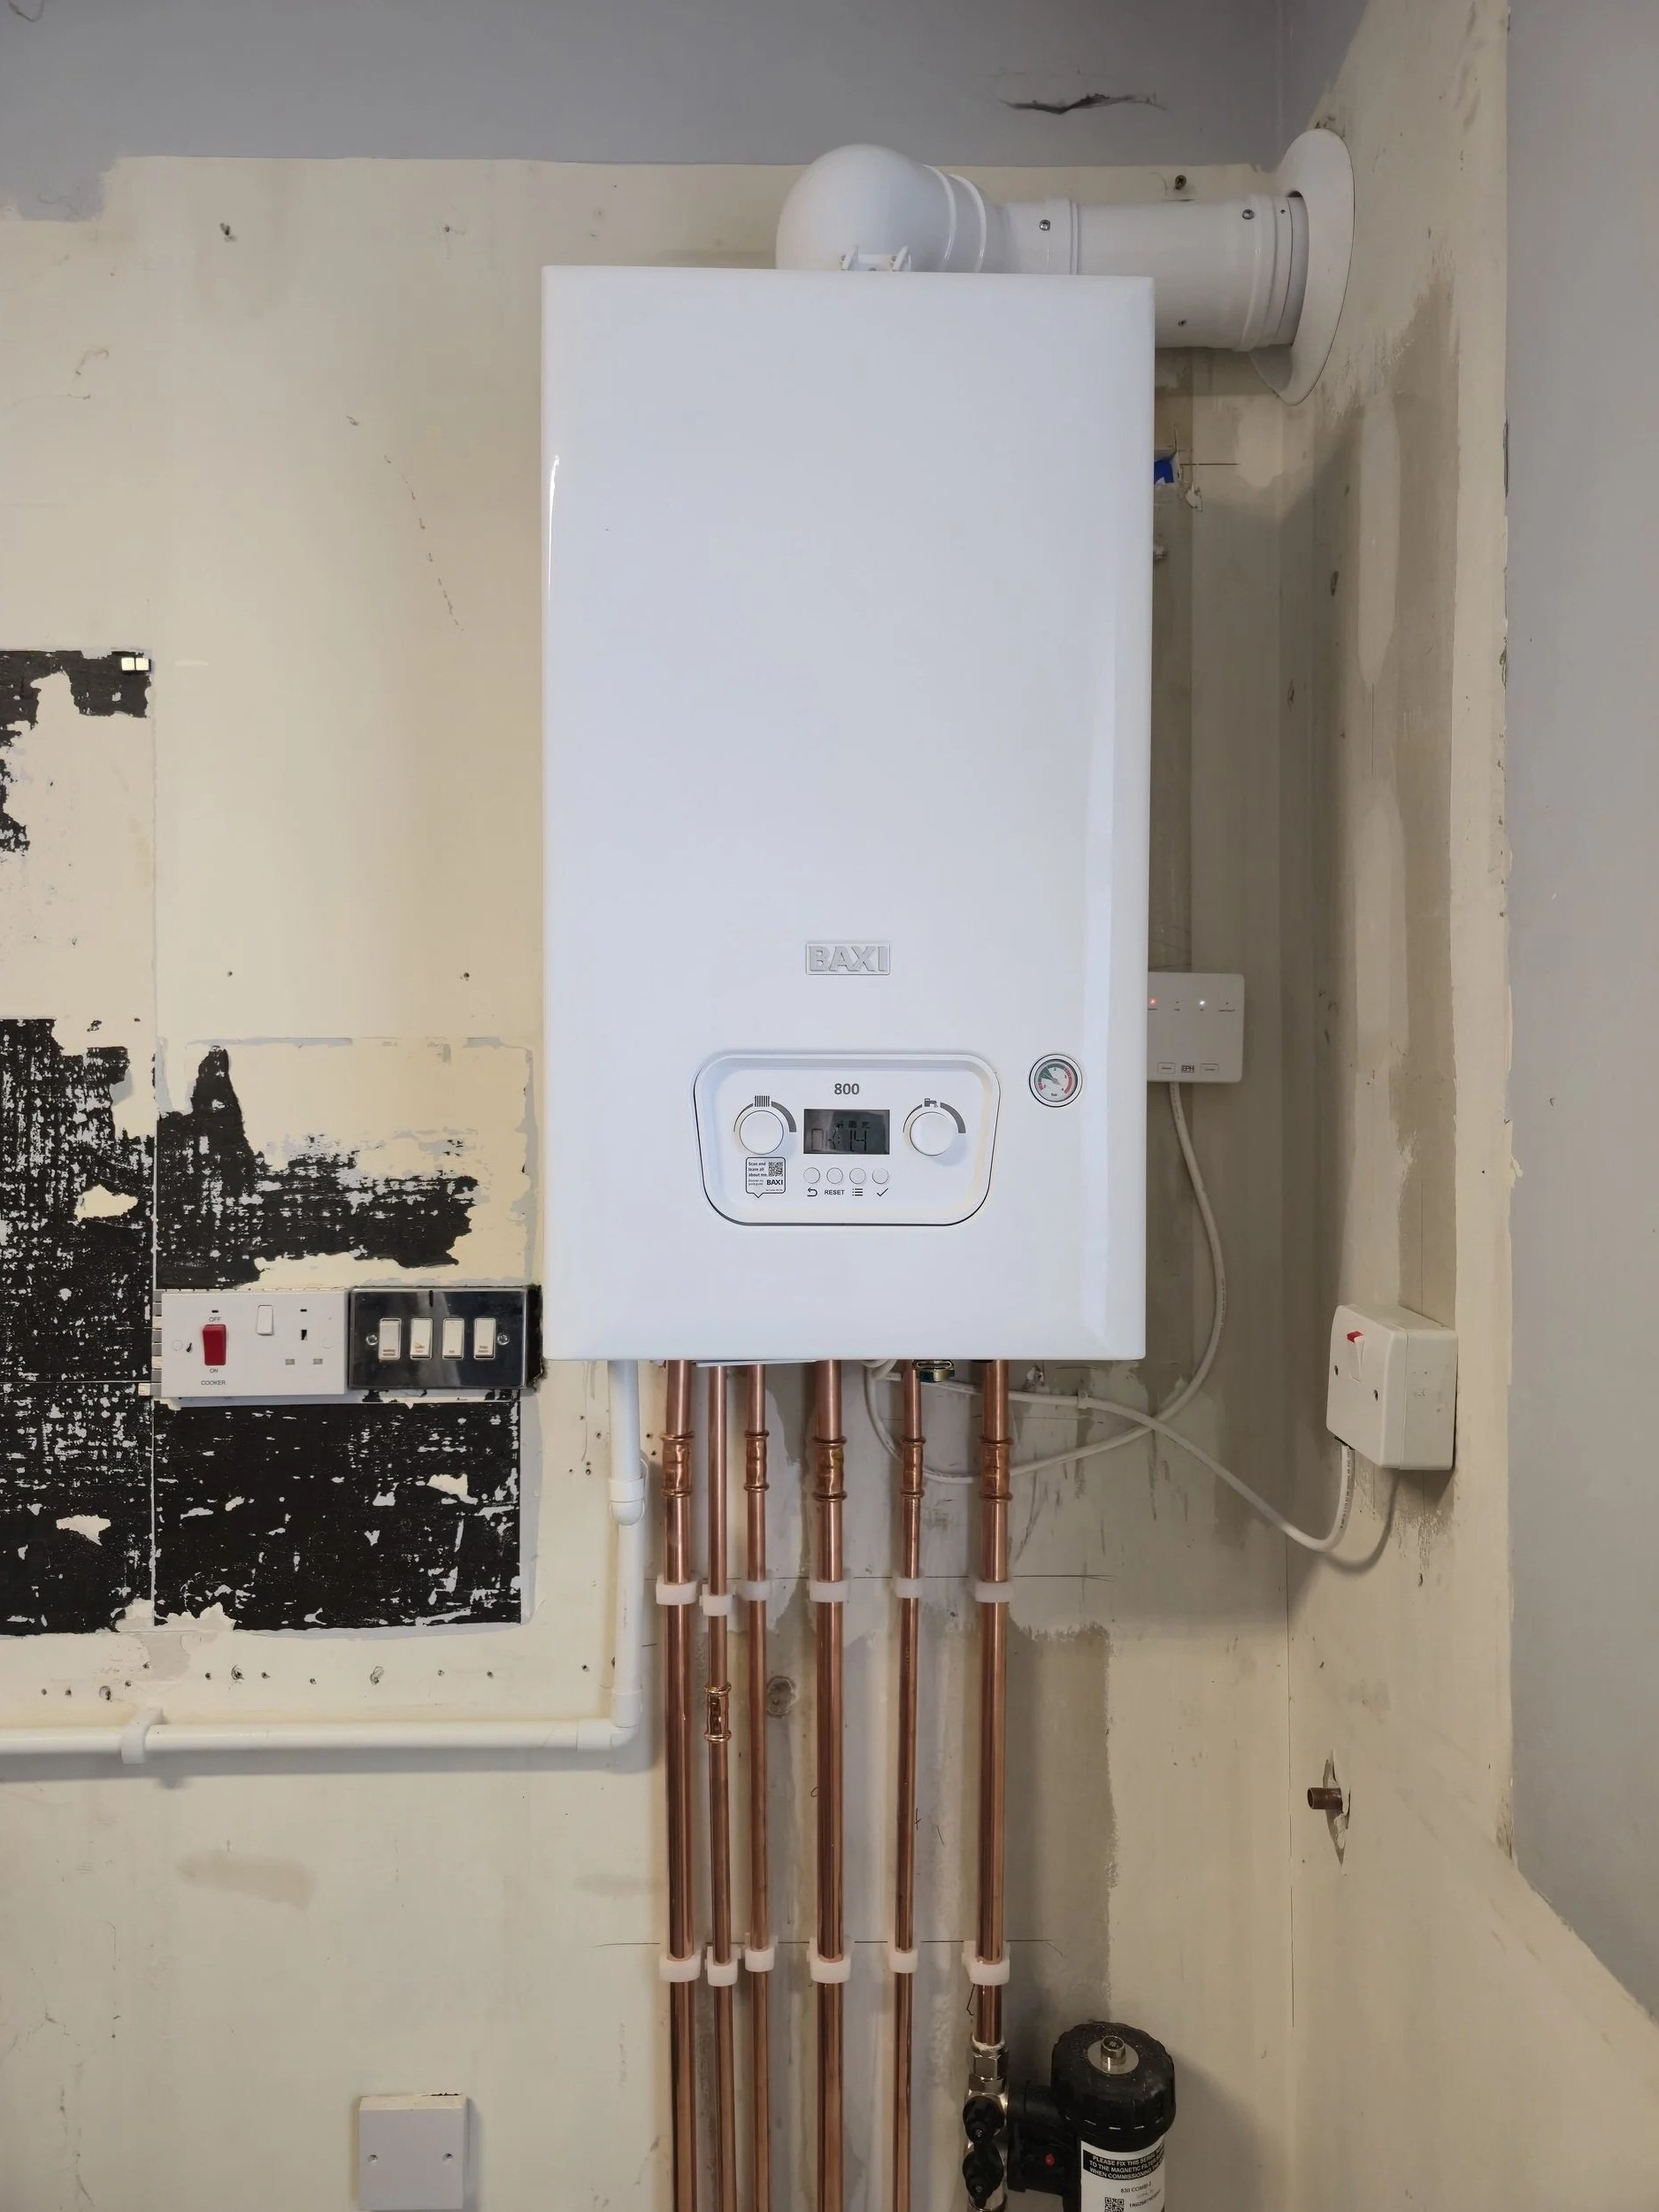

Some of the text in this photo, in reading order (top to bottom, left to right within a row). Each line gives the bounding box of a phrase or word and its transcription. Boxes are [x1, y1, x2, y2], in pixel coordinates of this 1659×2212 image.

[809, 946, 887, 972] BAXI
[1181, 1064, 1194, 1073] EPH
[834, 1083, 860, 1094] 800
[1093, 2155, 1115, 2166] PLEASE
[1089, 2167, 1107, 2177] WHEN
